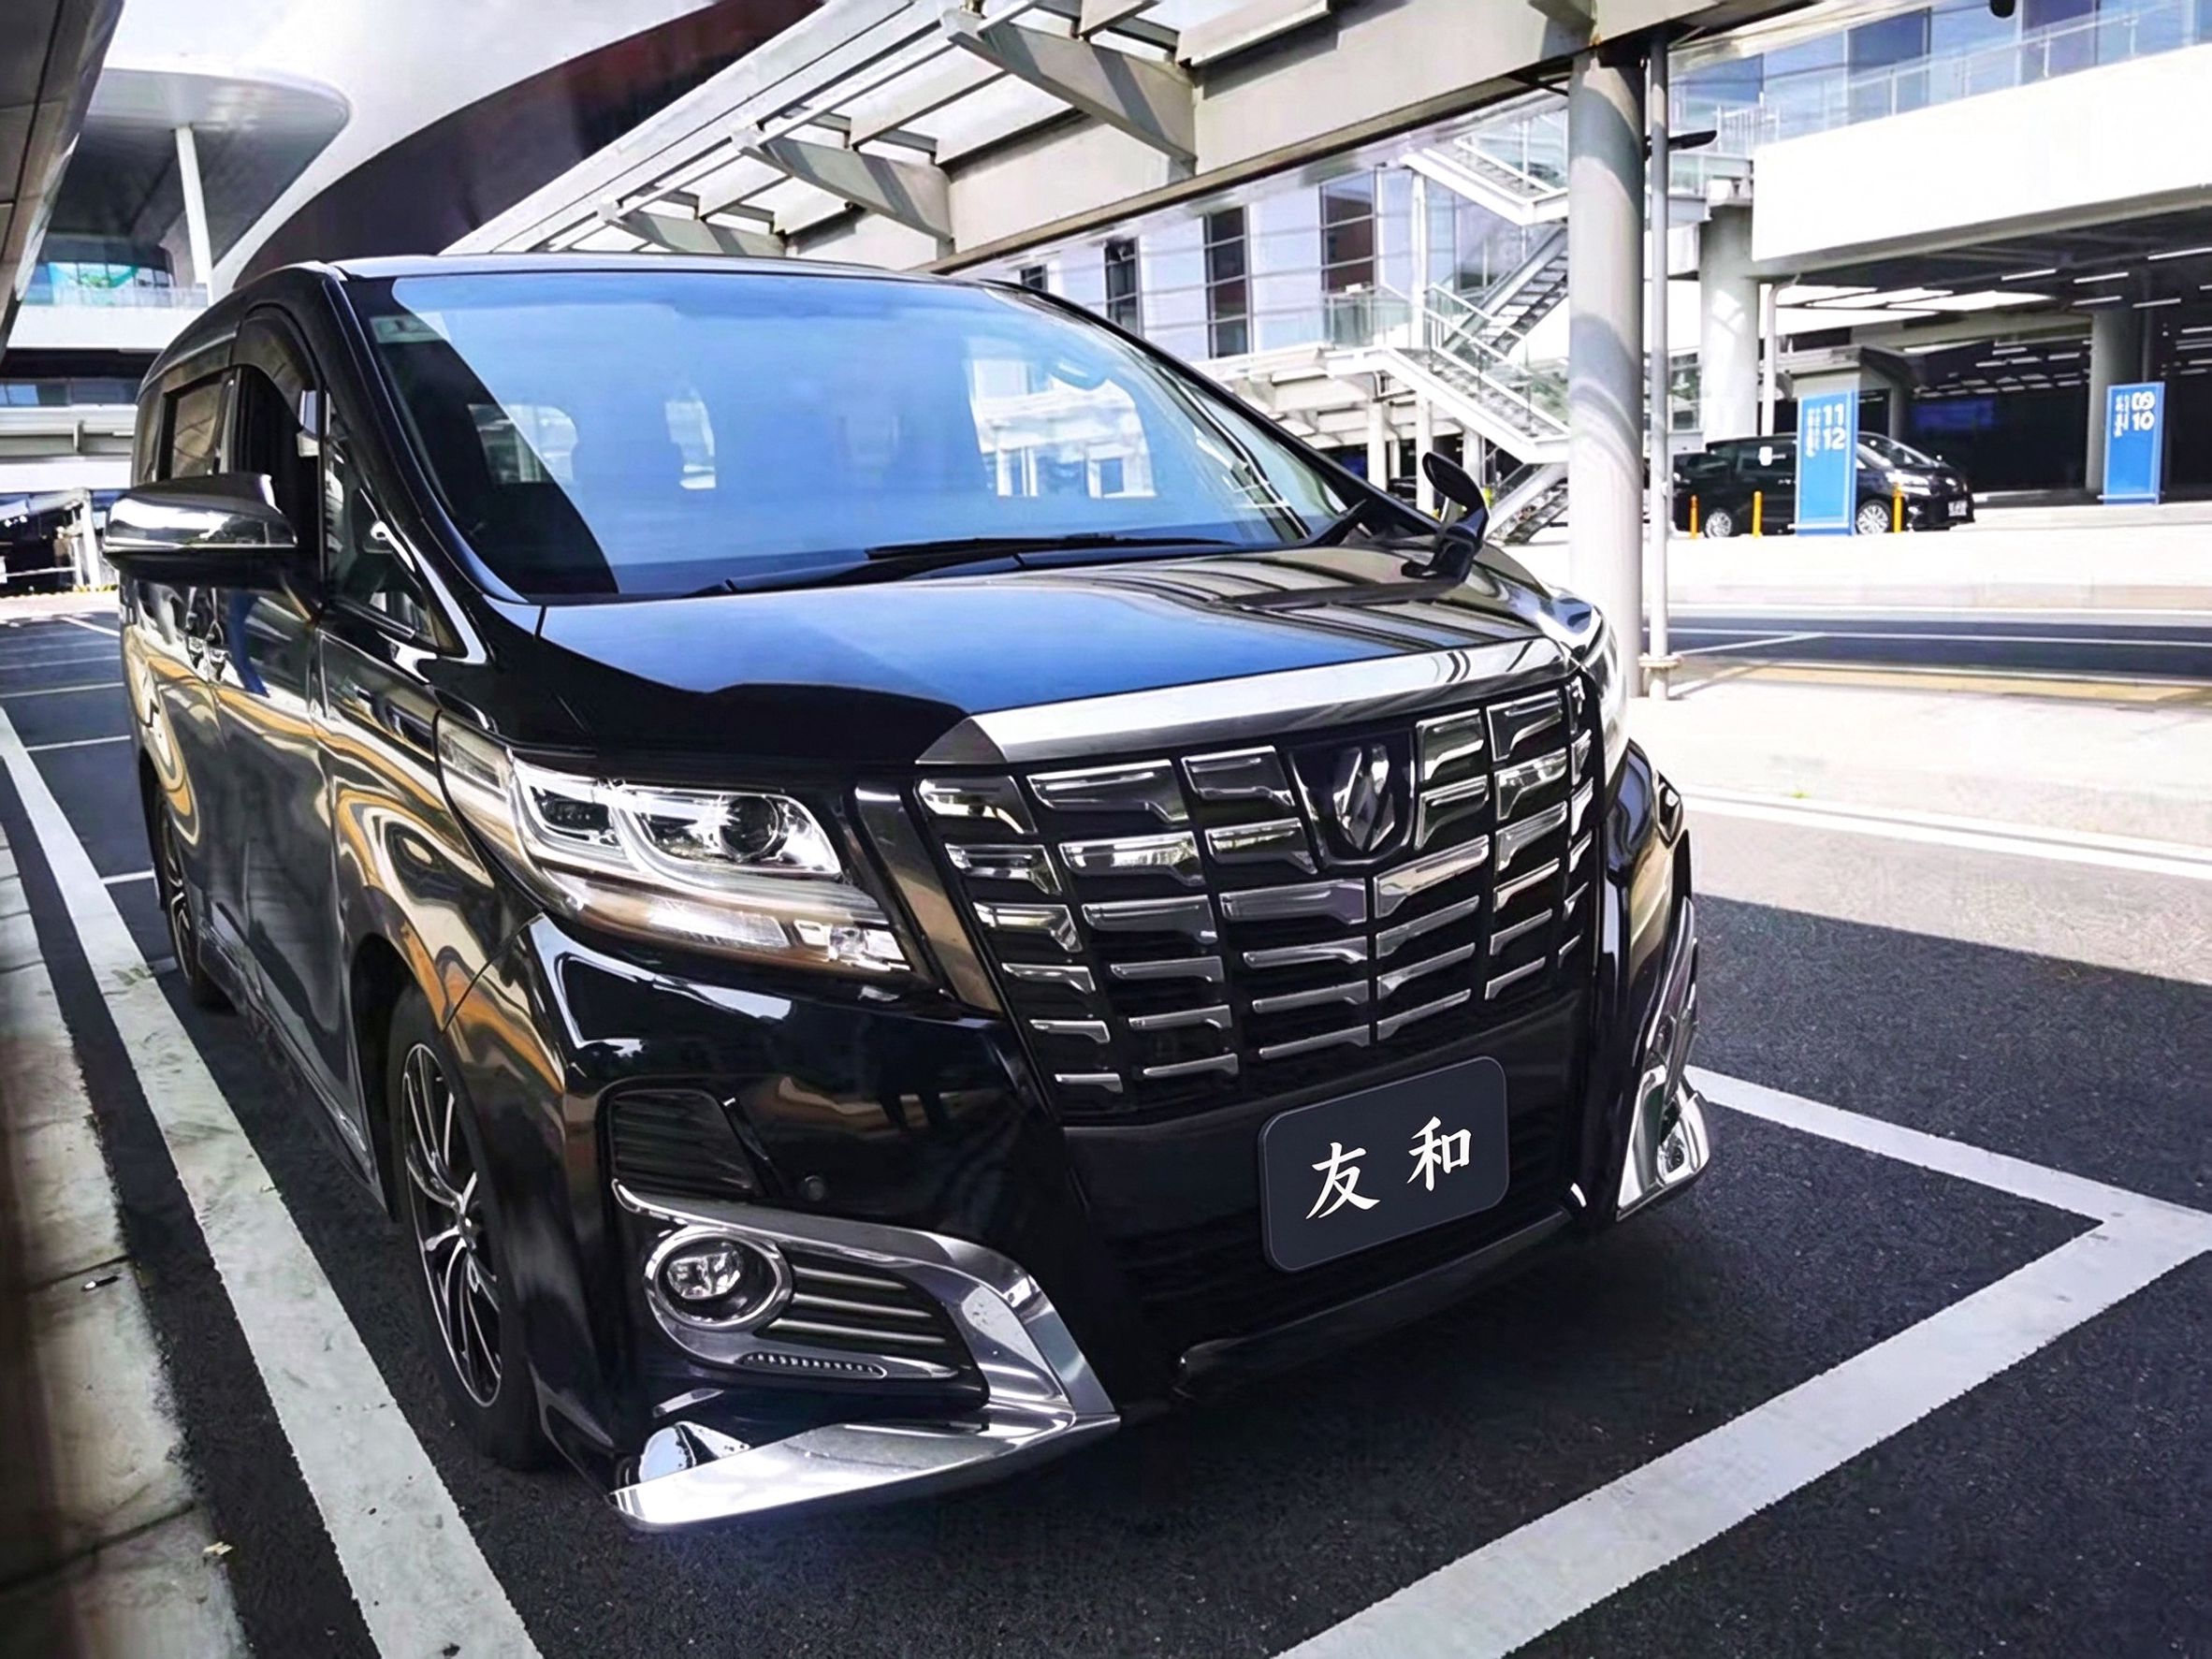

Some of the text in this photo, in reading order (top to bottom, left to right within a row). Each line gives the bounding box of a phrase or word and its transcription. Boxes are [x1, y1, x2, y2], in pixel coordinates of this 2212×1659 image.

[2132, 391, 2155, 411] 09
[1823, 404, 1844, 426] 11
[2132, 410, 2155, 430] 10
[1823, 427, 1845, 450] 12
